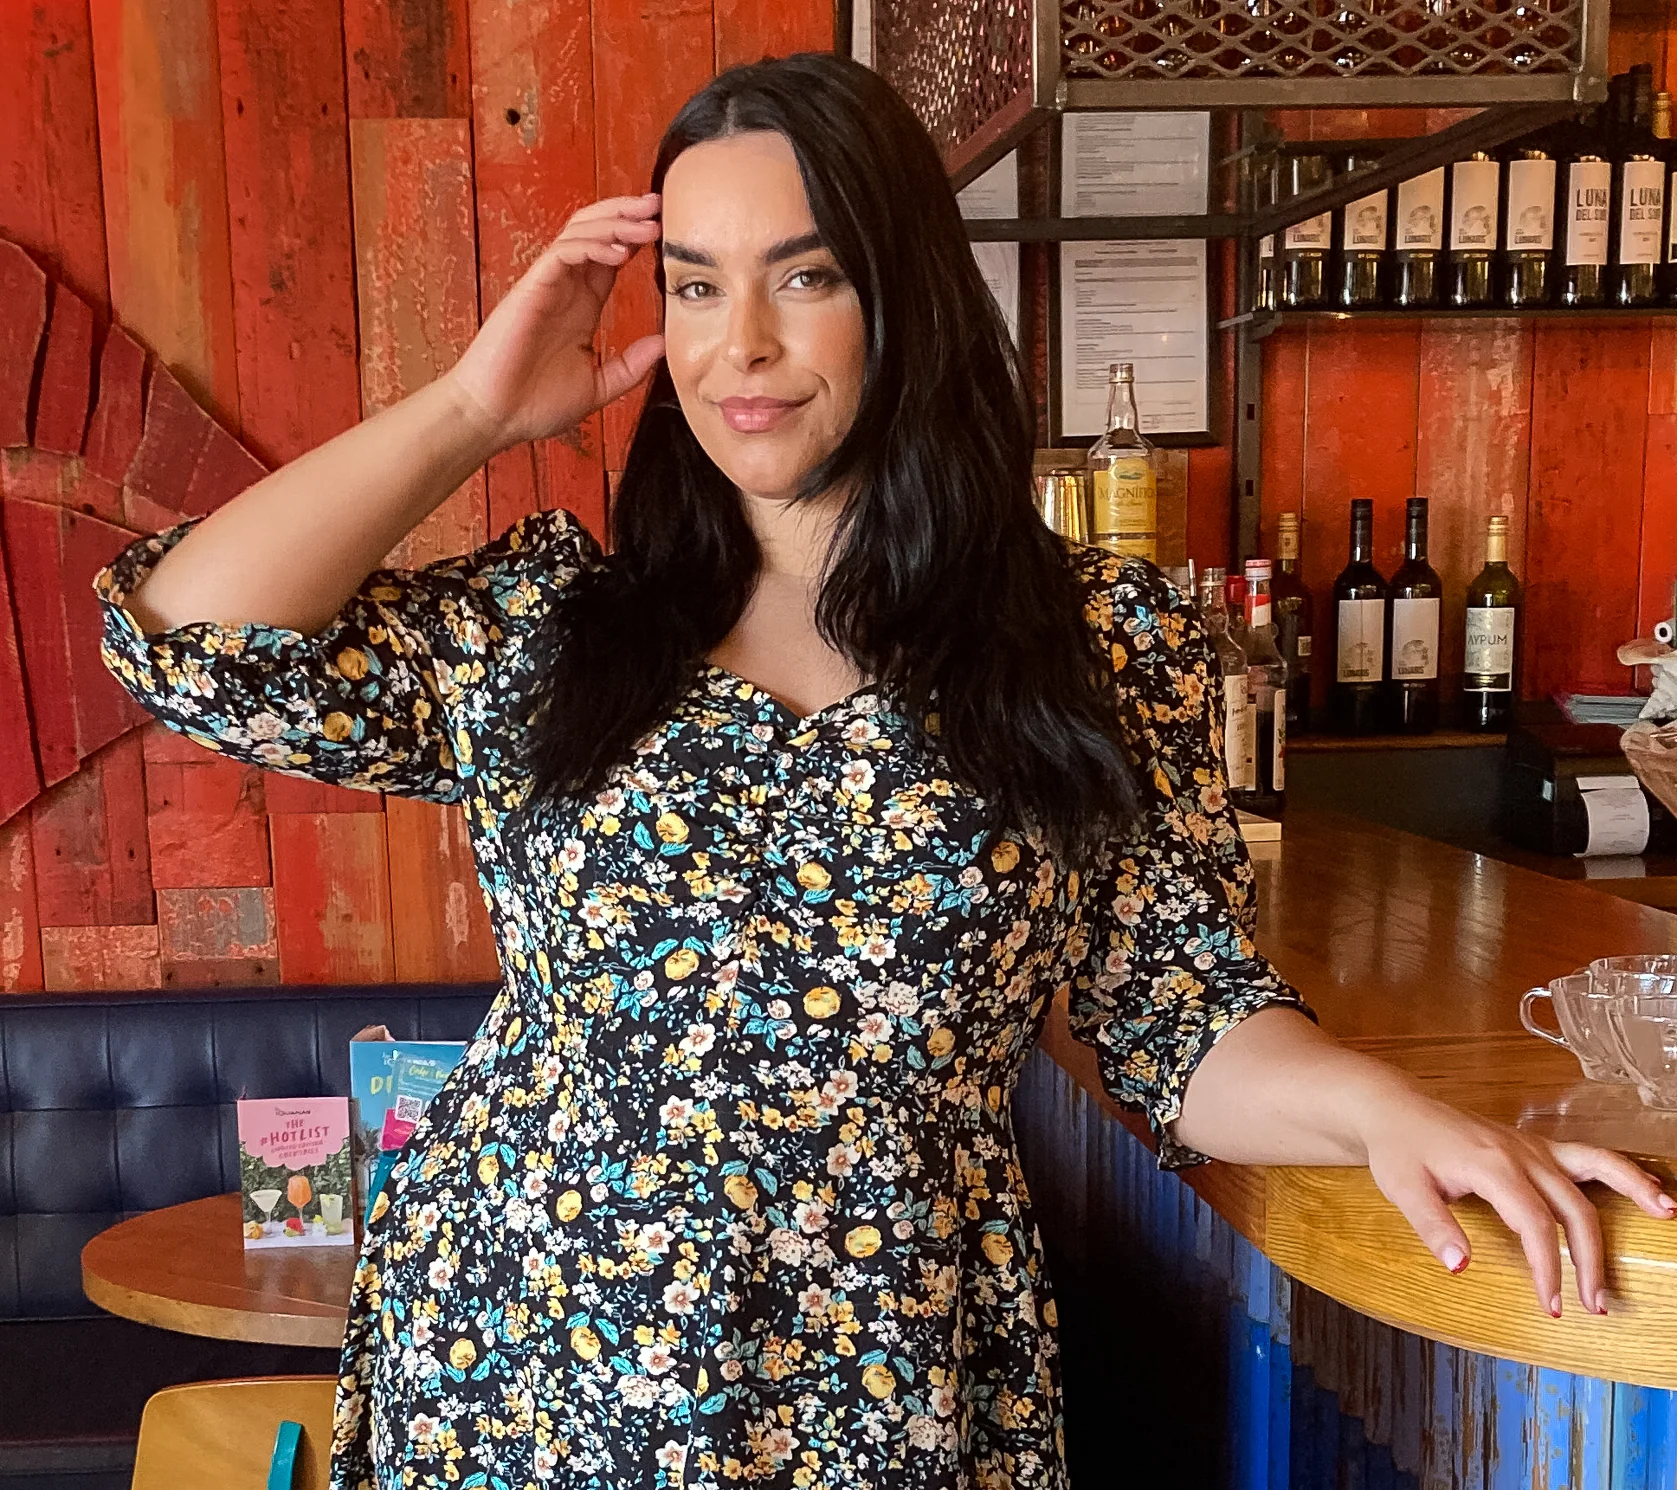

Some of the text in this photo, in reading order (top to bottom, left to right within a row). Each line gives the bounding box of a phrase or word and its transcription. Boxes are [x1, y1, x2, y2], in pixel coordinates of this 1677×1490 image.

[1576, 188, 1607, 207] LUNA
[1630, 187, 1660, 207] LUNA
[286, 1119, 304, 1129] THE
[260, 1125, 331, 1146] #HOTLIST
